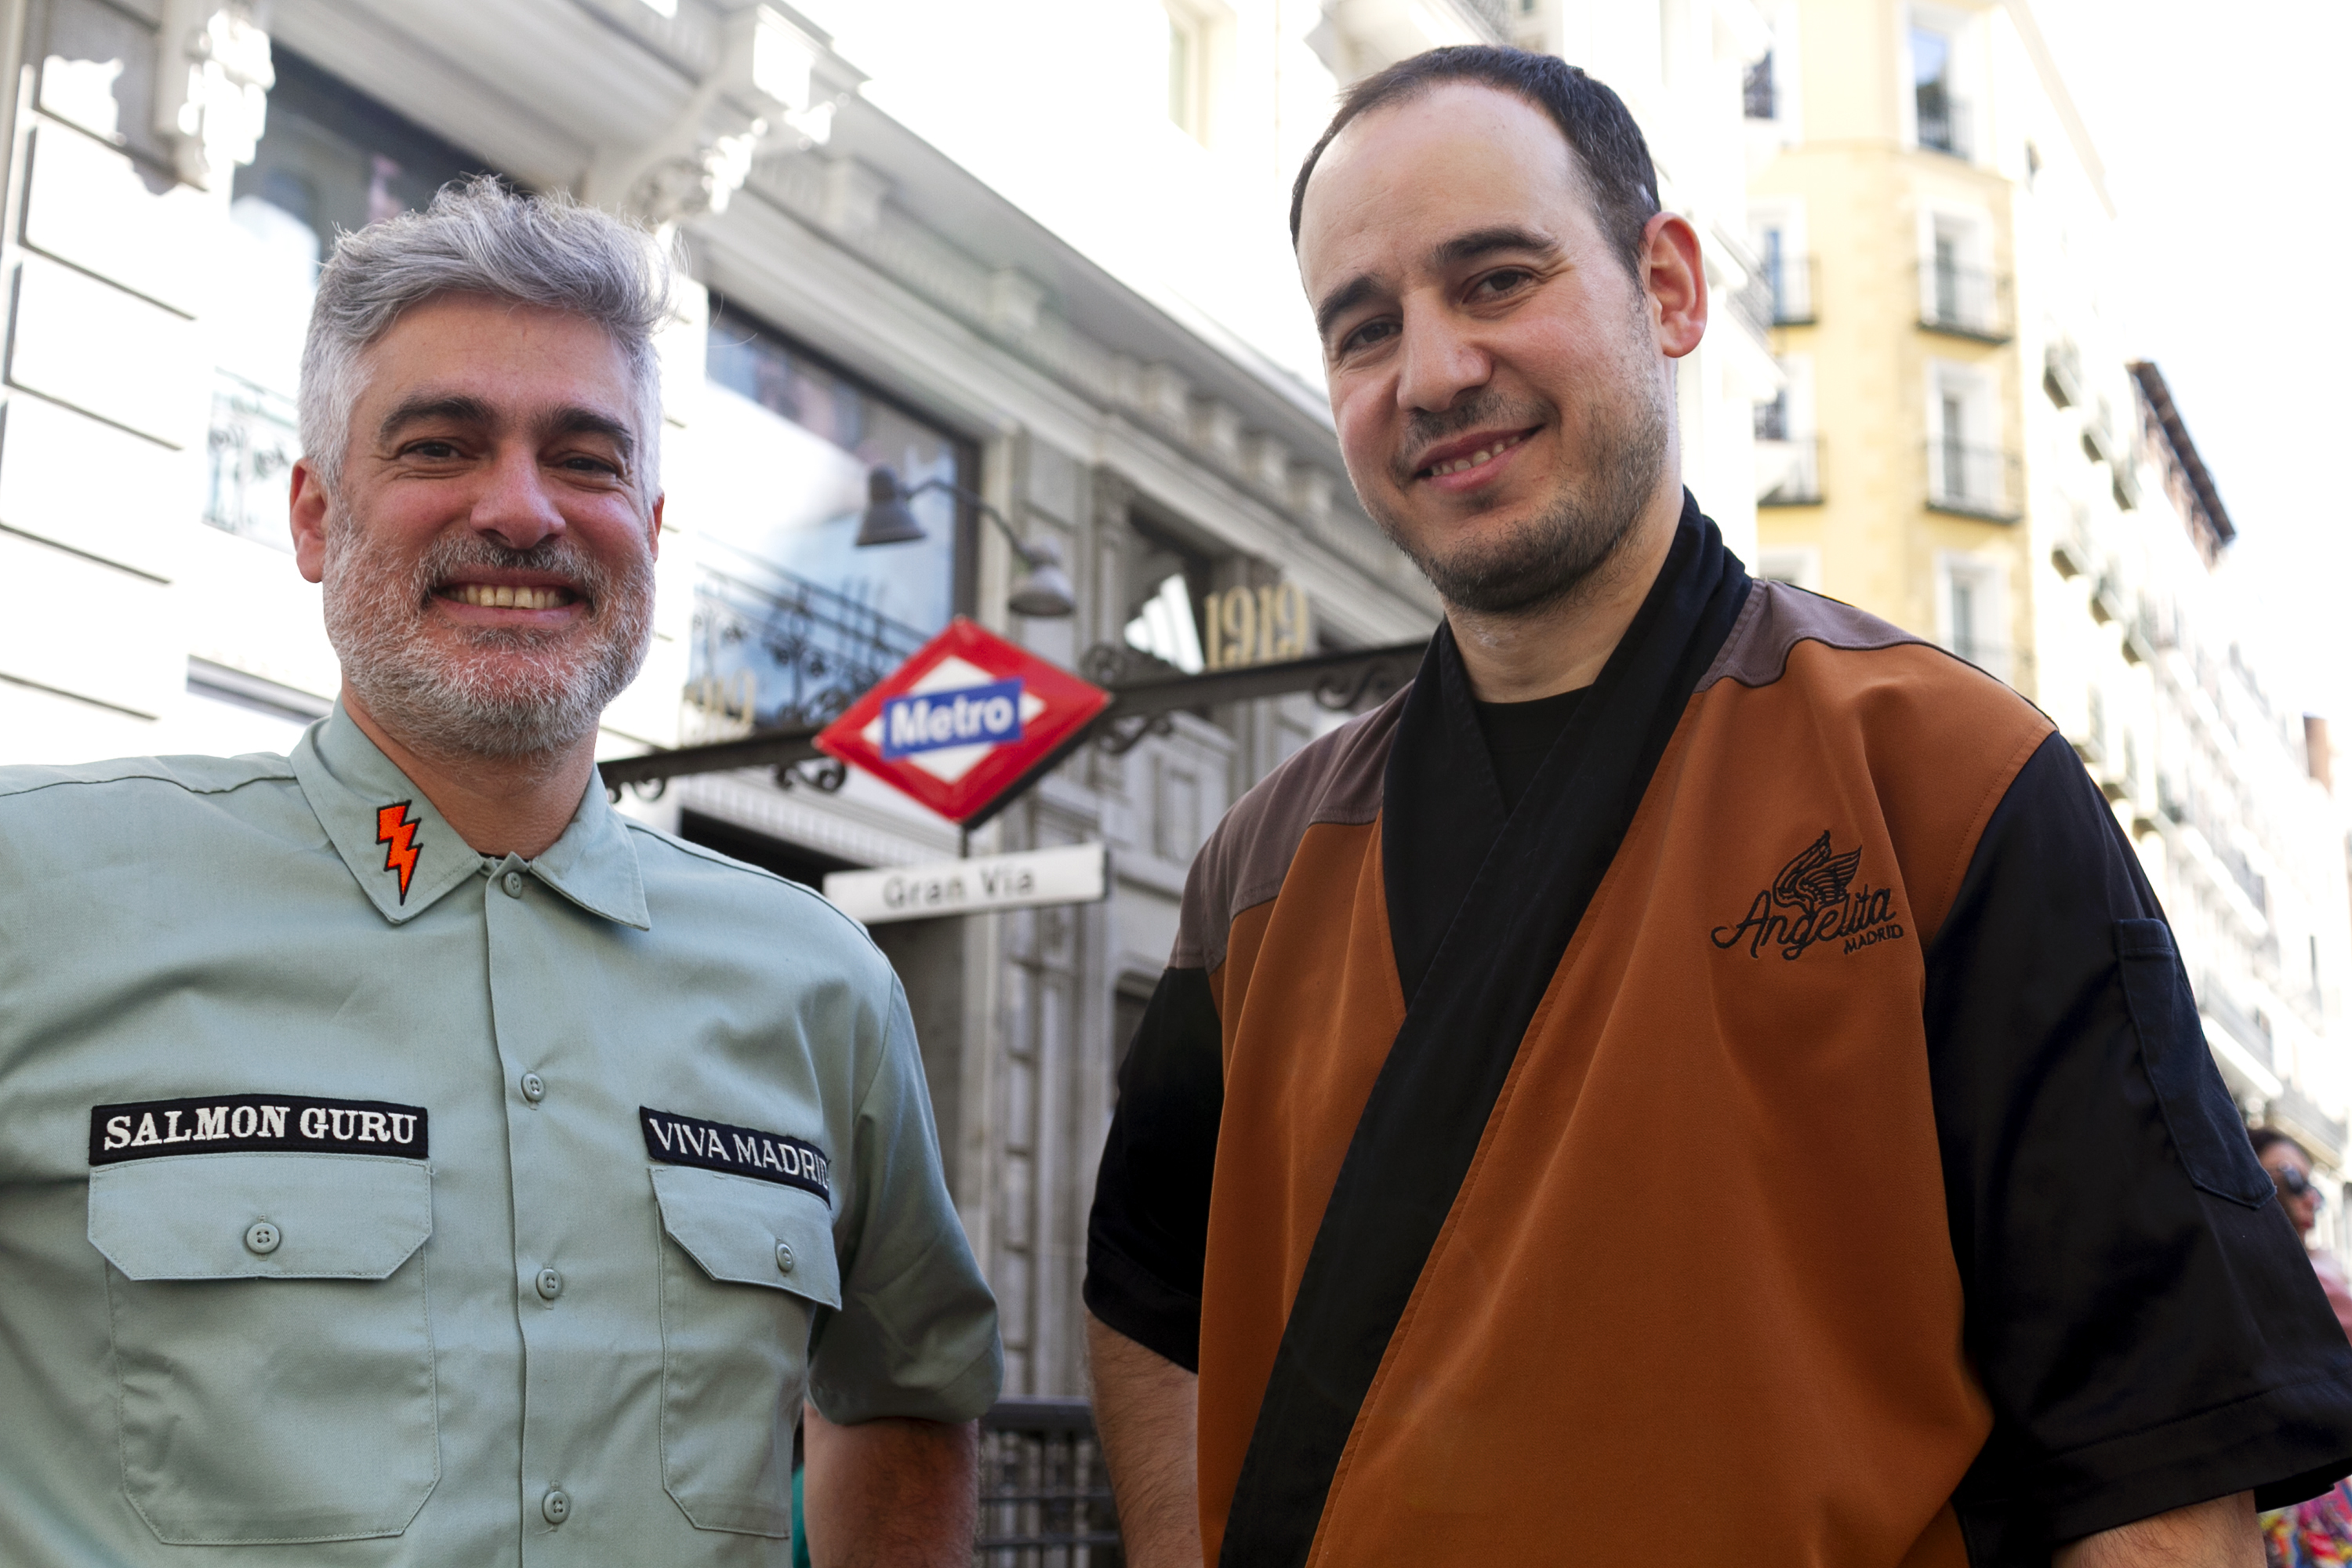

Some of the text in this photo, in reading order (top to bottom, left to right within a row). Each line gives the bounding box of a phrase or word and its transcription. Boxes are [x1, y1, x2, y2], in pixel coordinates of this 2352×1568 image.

[1204, 582, 1309, 670] 1919
[891, 695, 1014, 748] Metro
[883, 876, 966, 908] Gran
[1711, 884, 1896, 960] Angelita
[1843, 924, 1904, 954] MADRID
[104, 1105, 417, 1150] SALMON GURU
[649, 1118, 731, 1162] VIVA
